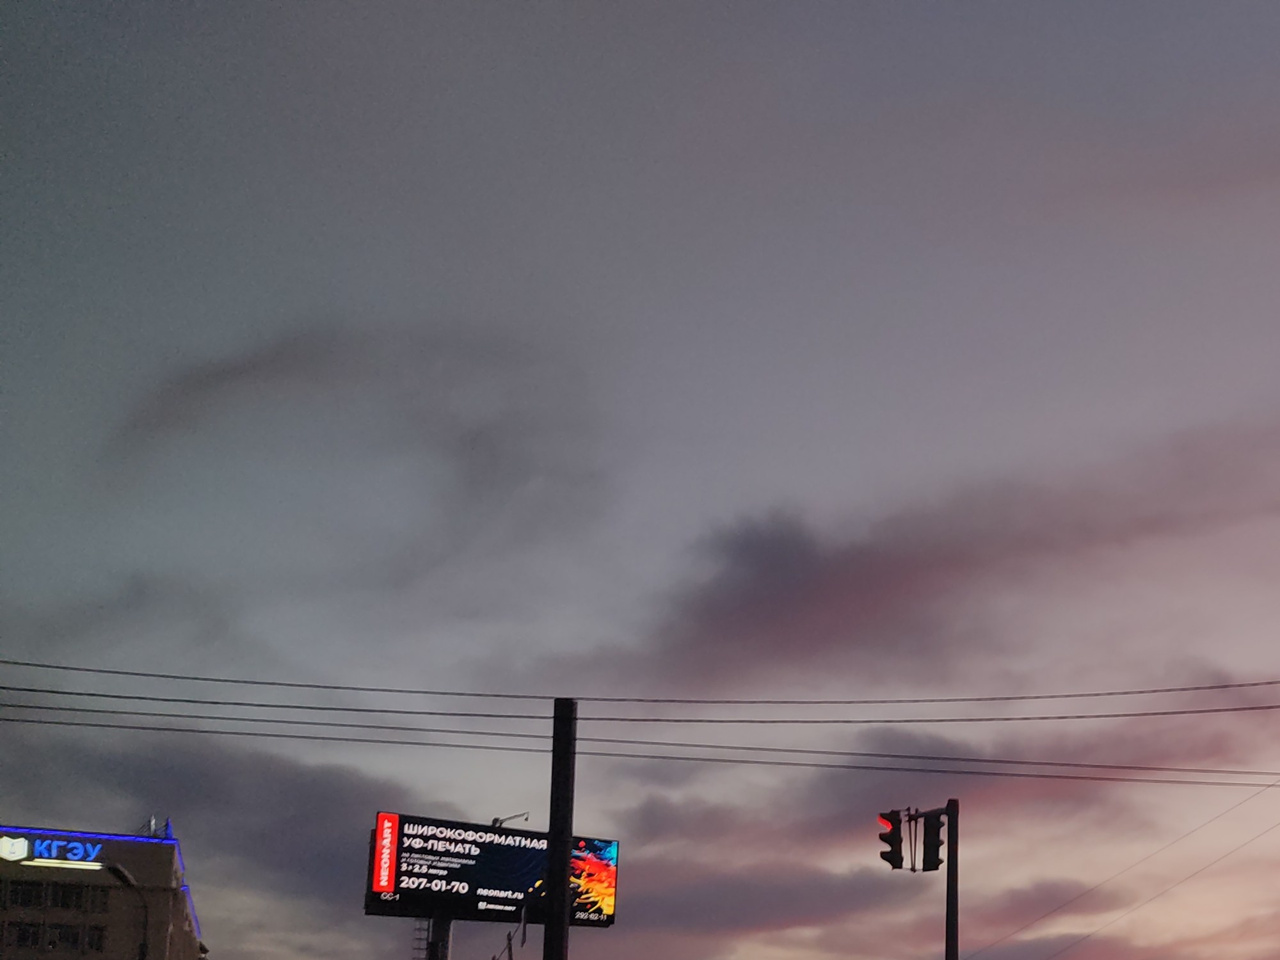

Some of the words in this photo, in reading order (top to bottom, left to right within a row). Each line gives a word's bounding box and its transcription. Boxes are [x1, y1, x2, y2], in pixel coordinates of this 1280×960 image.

[402, 837, 481, 856] УФ-ПЕЧАТЬ
[403, 822, 548, 850] ШИРОКОФОРМАТНАЯ
[33, 839, 102, 861] КГЭУ
[379, 819, 393, 887] NEONART
[399, 876, 469, 894] 207-01-70
